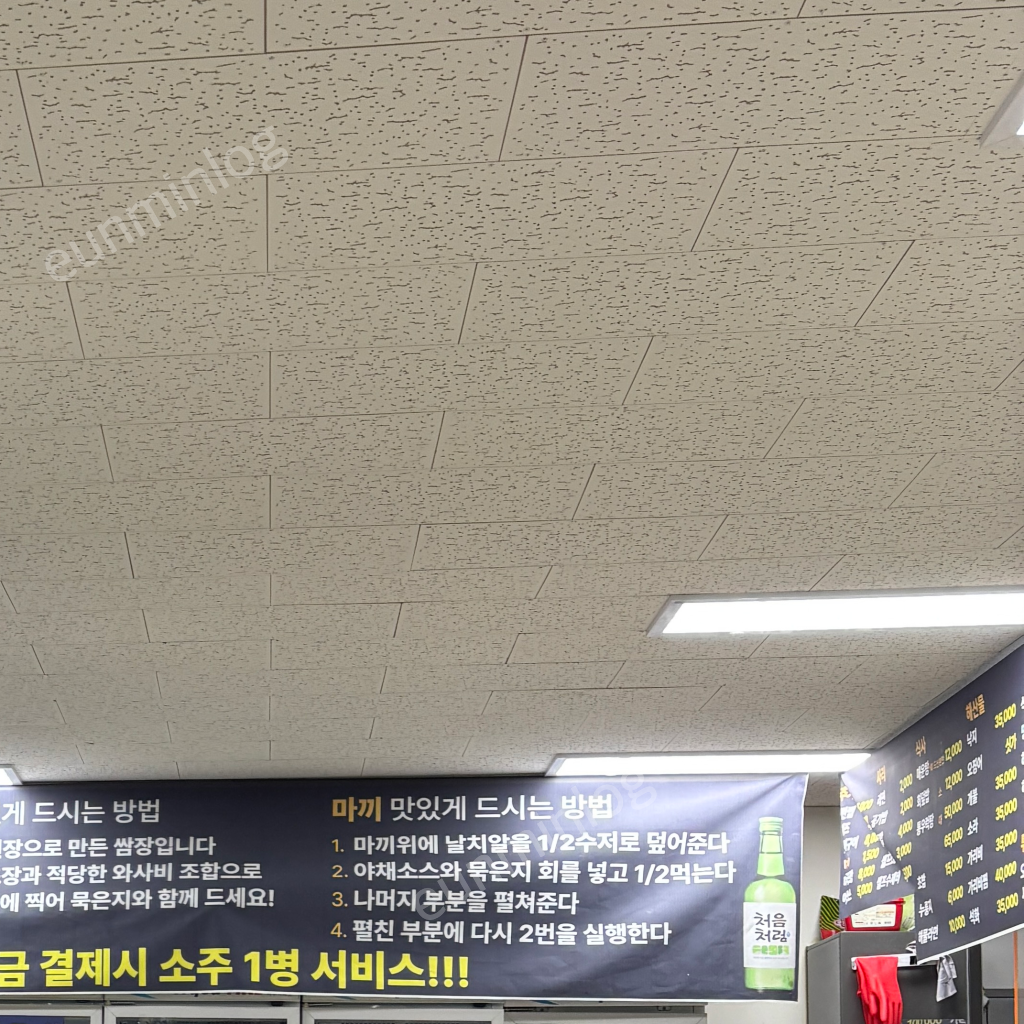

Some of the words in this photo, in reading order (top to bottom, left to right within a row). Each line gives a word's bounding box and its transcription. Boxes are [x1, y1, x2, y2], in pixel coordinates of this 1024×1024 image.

[966, 694, 985, 721] 해산물
[994, 703, 1017, 729] 35,000
[945, 740, 963, 763] 12,000
[967, 754, 983, 777] 오징어
[945, 769, 963, 791] 12,000
[995, 766, 1017, 790] 35,000
[32, 800, 105, 825] 드시는
[113, 799, 160, 823] 방법
[332, 796, 381, 822] 마끼
[390, 795, 466, 821] 맛있게
[475, 795, 553, 820] 드시는
[561, 794, 613, 819] 방법
[944, 798, 963, 820] 50,000
[995, 798, 1018, 821] 35,000
[68, 837, 108, 858] 만든
[113, 836, 216, 858] 쌈장입니다
[331, 839, 344, 853] 1.
[354, 835, 438, 855] 마끼위에
[445, 833, 532, 854] 날치알을
[538, 831, 640, 853] 1/2수저로
[647, 831, 731, 855] 덮어준다
[944, 827, 963, 848] 65,000
[995, 829, 1018, 852] 35,000
[896, 842, 912, 861] 3,000
[47, 864, 107, 885] 적당한
[112, 862, 172, 883] 와사비
[179, 862, 262, 881] 조합으로
[331, 865, 348, 878] 2.
[354, 861, 462, 881] 야채소스와
[467, 860, 531, 883] 묵은지
[538, 860, 581, 884] 회를
[587, 862, 628, 885] 넣고
[634, 860, 737, 886] 1/2먹는다
[945, 856, 963, 876] 15,000
[994, 861, 1017, 883] 40,000
[24, 891, 65, 912] 찍어
[71, 889, 152, 910] 묵은지와
[157, 888, 198, 908] 함께
[204, 887, 275, 908] 드세요!
[331, 892, 348, 907] 3.
[354, 889, 416, 911] 나머지
[423, 890, 488, 913] 부분을
[494, 890, 580, 915] 펼쳐준다
[947, 885, 964, 905] 6,000
[996, 892, 1019, 914] 35,000
[753, 911, 787, 928] 처음
[948, 915, 965, 934] 10,000
[330, 922, 347, 938] 4.
[352, 919, 394, 942] 펼친
[400, 921, 464, 943] 부분에
[471, 921, 512, 945] 다시
[519, 923, 578, 946] 2번을
[583, 922, 672, 946] 실행한다
[754, 927, 788, 943] 처럼
[39, 947, 147, 988] 결제시
[158, 947, 233, 986] 소주
[243, 948, 299, 988] 1병
[311, 949, 469, 990] 서비스!!!
